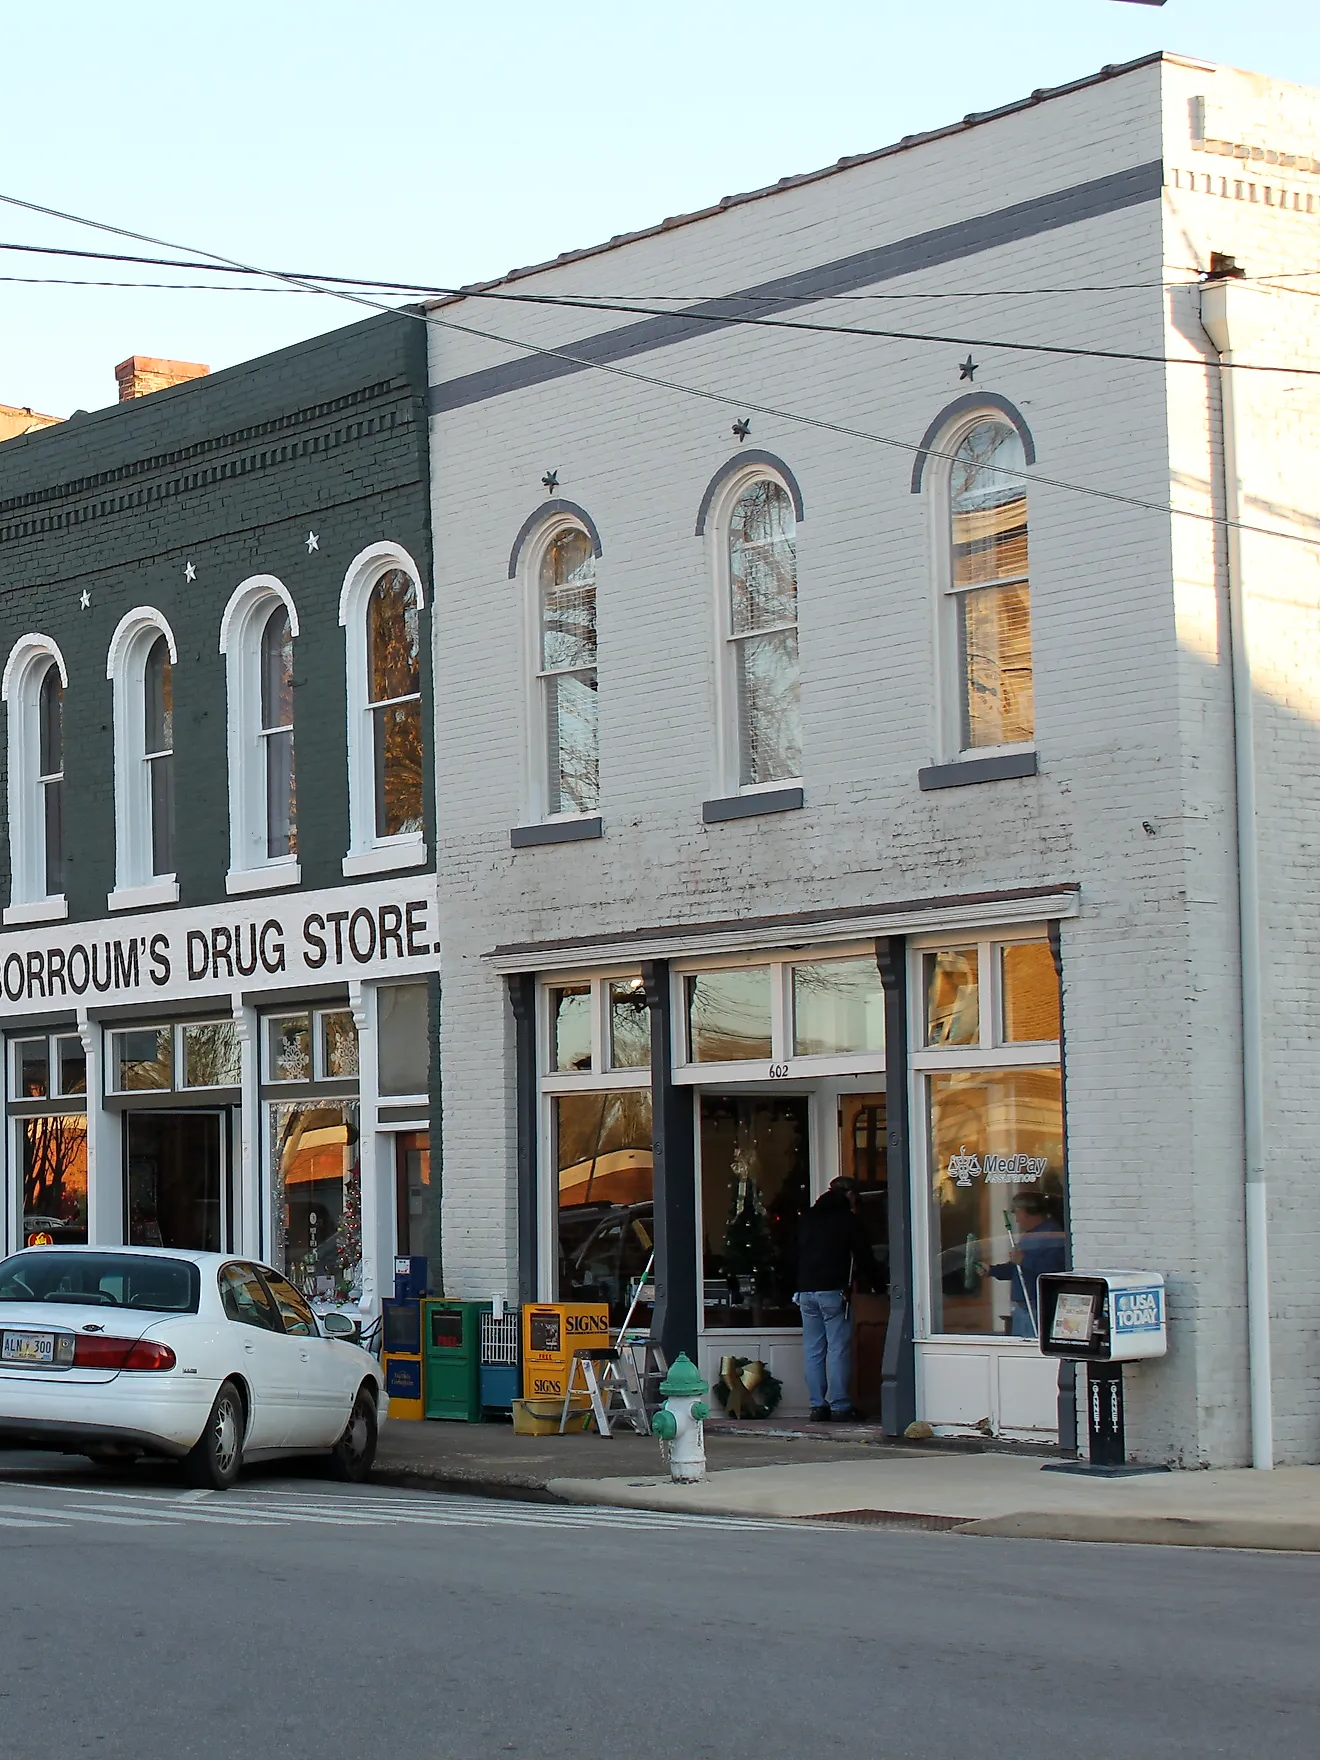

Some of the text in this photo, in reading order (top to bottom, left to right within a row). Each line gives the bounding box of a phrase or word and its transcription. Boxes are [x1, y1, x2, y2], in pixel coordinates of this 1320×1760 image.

[186, 918, 286, 982] DRUG
[302, 900, 441, 970] STORE.
[769, 1063, 789, 1079] 602
[983, 1153, 1048, 1178] MedPay
[984, 1173, 1038, 1184] Assurance
[1129, 1293, 1157, 1310] USA
[565, 1315, 609, 1332] SIGNS
[1116, 1308, 1159, 1328] TODAY
[4, 1338, 52, 1354] ALN 300
[533, 1379, 561, 1393] SIGNS
[1092, 1384, 1101, 1433] GANNETT
[1110, 1384, 1119, 1433] GANNETT
